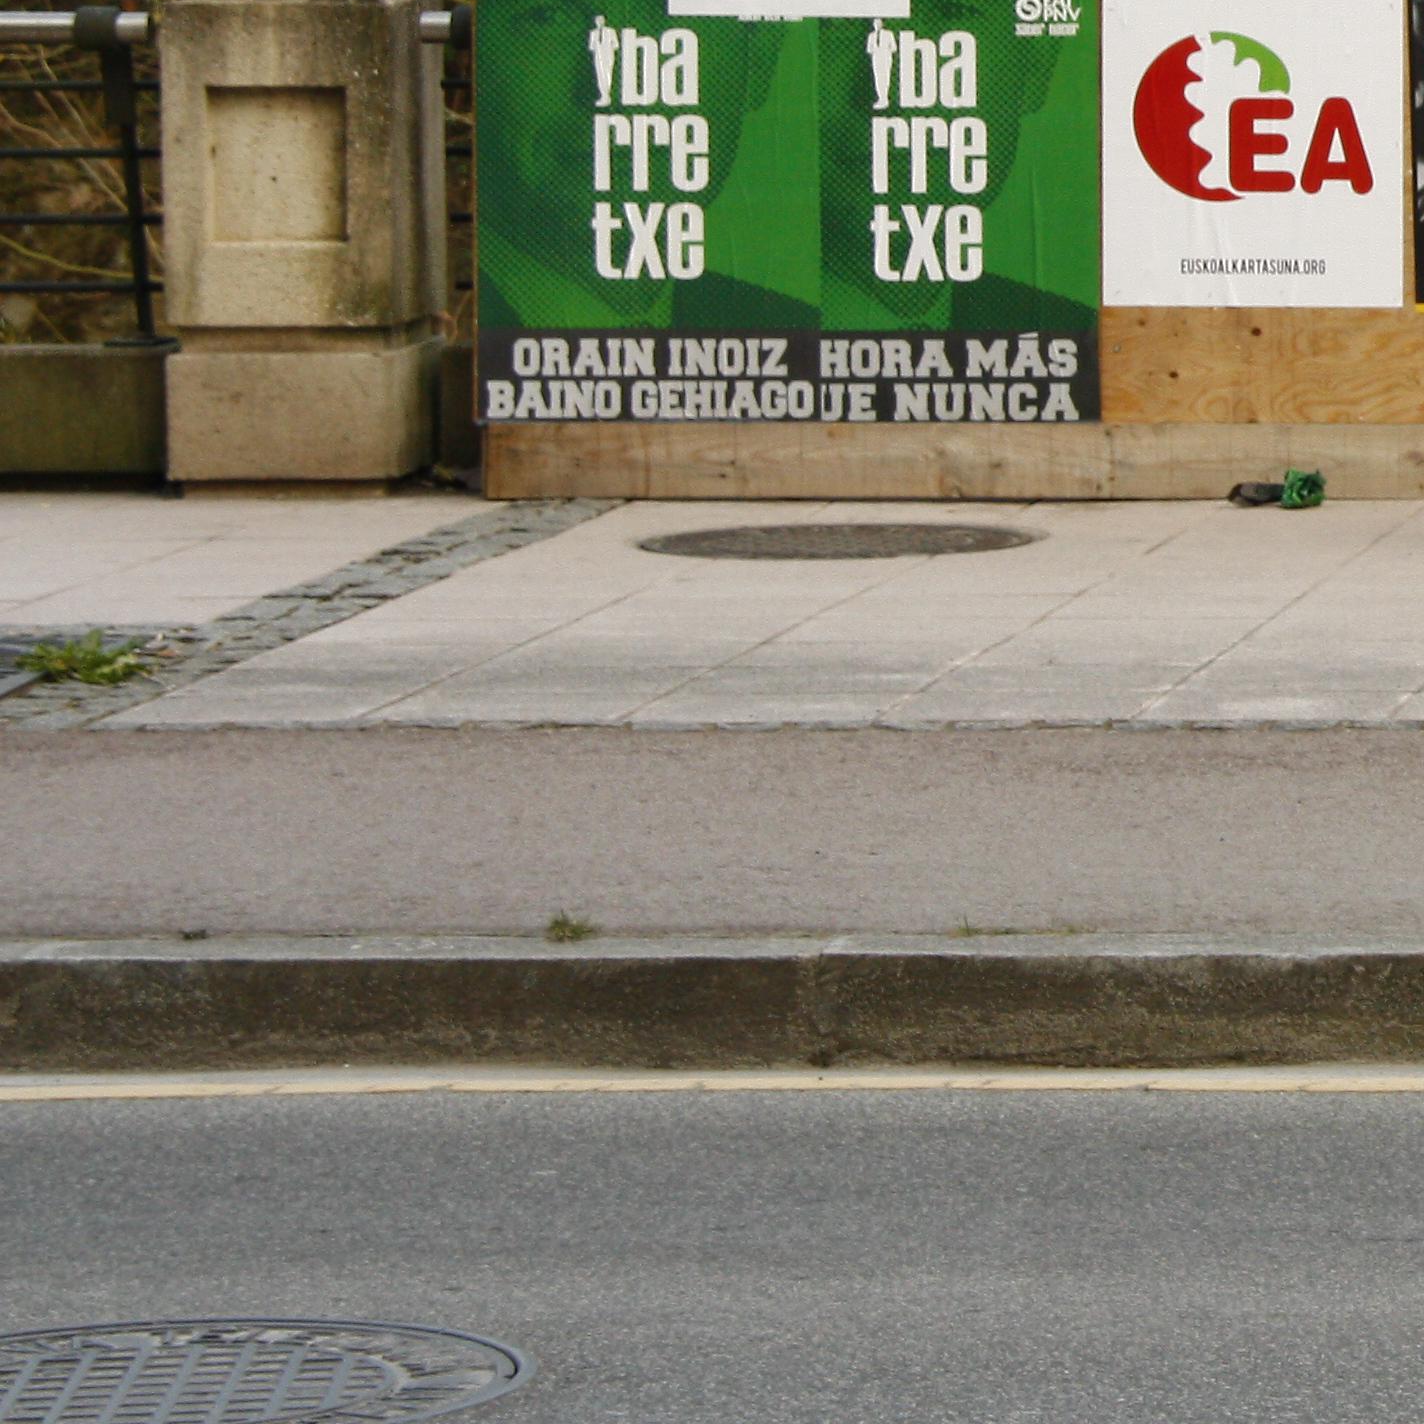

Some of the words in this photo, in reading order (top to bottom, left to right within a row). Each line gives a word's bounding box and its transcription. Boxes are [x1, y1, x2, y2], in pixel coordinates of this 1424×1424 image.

[593, 114, 710, 192] rre
[871, 116, 988, 195] rre
[1227, 96, 1375, 195] EA
[592, 202, 706, 281] txe
[870, 204, 984, 283] txe
[1180, 258, 1326, 277] EUSKOALKARTASUNA.ORG
[513, 338, 657, 377] ORAIN
[668, 338, 788, 377] INOIZ
[819, 339, 954, 378] HORA
[966, 332, 1079, 378] MÁS
[487, 380, 623, 419] BAINO
[630, 380, 815, 420] GEHIAGO
[820, 382, 877, 422] UE
[893, 382, 1080, 422] NUNCA
